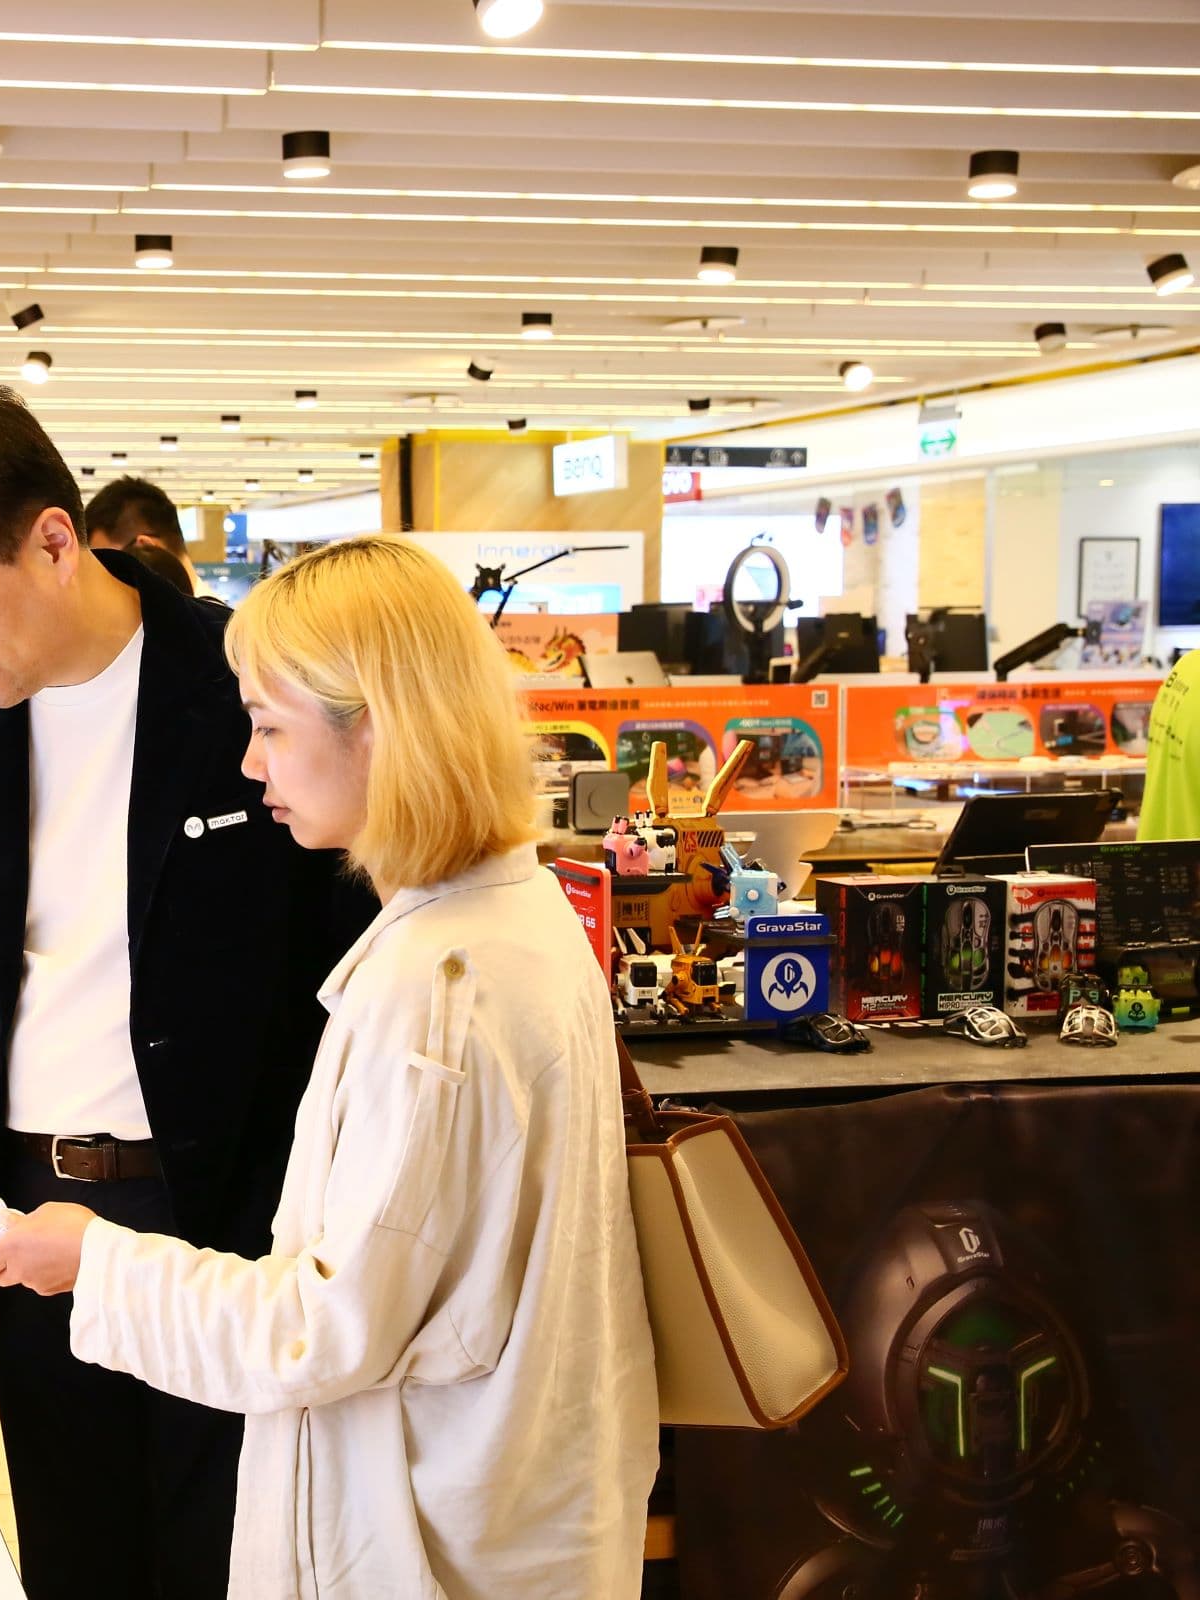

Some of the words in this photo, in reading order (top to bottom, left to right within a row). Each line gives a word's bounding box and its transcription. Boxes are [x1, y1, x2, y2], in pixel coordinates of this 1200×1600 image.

[756, 921, 822, 933] GravaStar
[861, 994, 908, 1003] MERCURY
[939, 992, 992, 1002] MERCURY
[861, 1003, 877, 1012] M2
